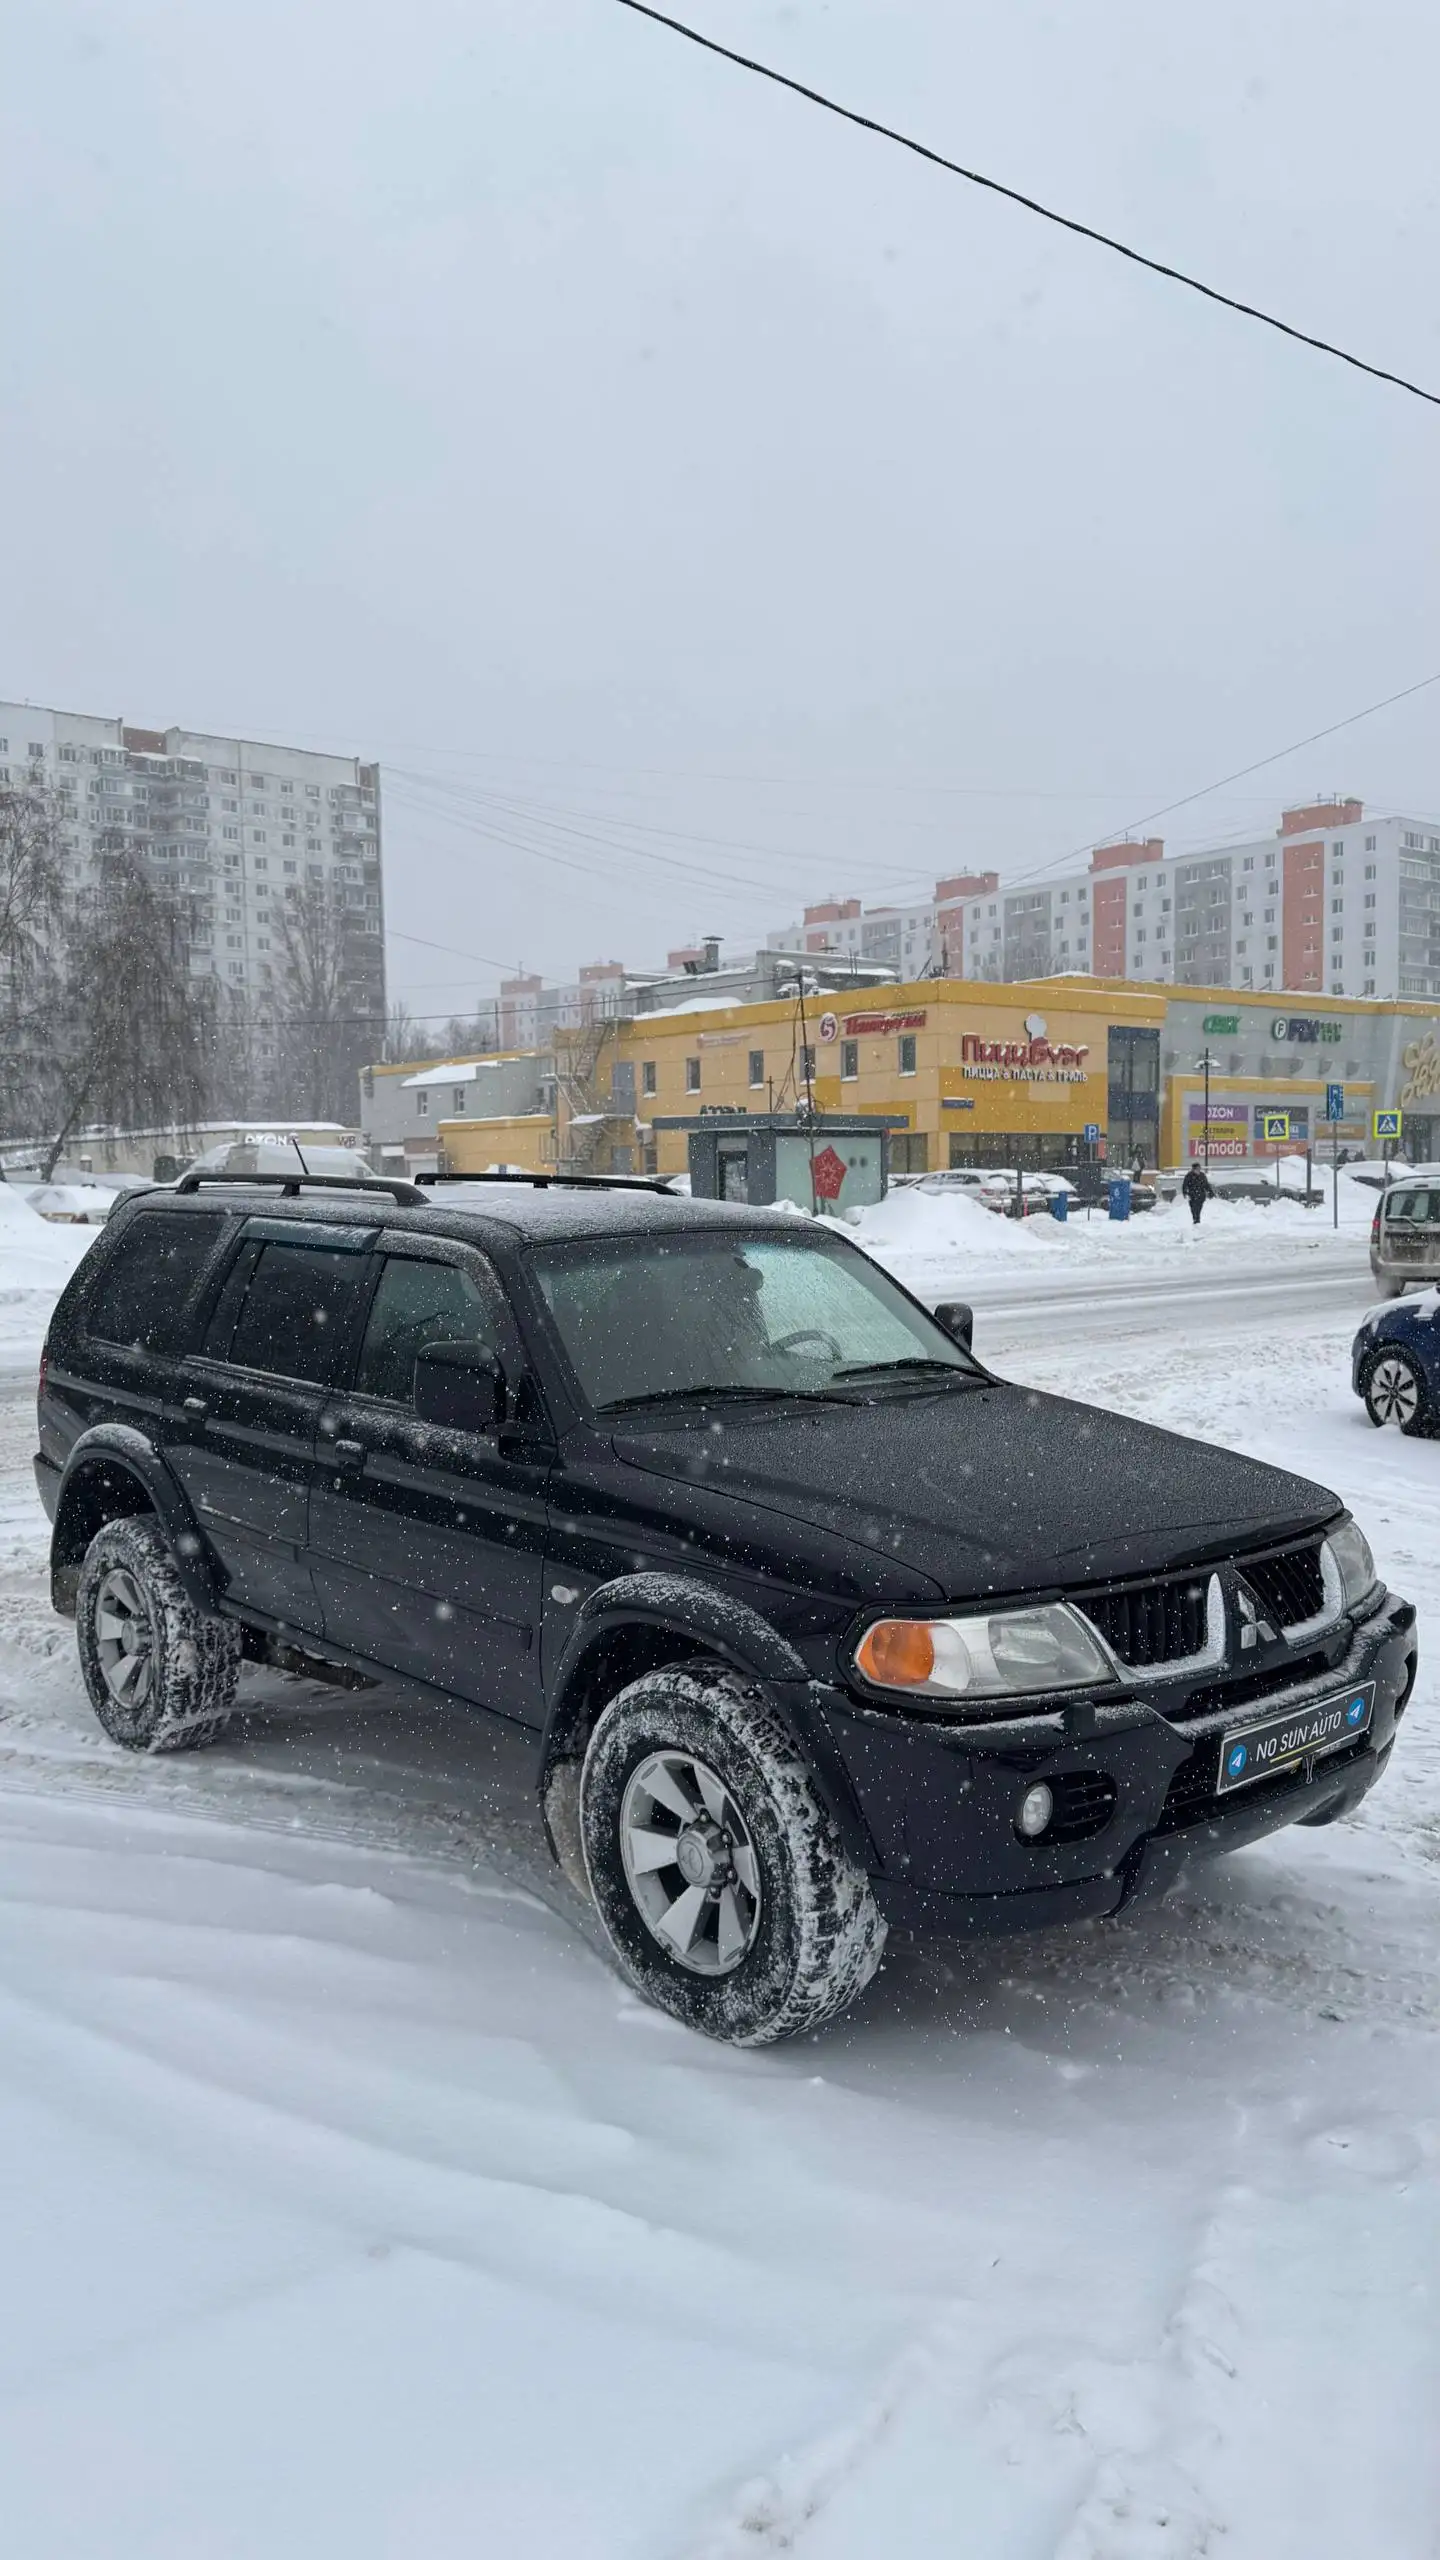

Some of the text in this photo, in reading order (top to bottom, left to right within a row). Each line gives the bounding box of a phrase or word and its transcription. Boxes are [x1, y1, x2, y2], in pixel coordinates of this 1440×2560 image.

[963, 1065, 999, 1080] ПИЦЦА
[1012, 1068, 1045, 1081] ПАСТА
[1194, 1140, 1243, 1156] lamoda
[1255, 1737, 1277, 1762] NO
[1279, 1726, 1308, 1752] SUN
[1308, 1711, 1342, 1741] AUTO
